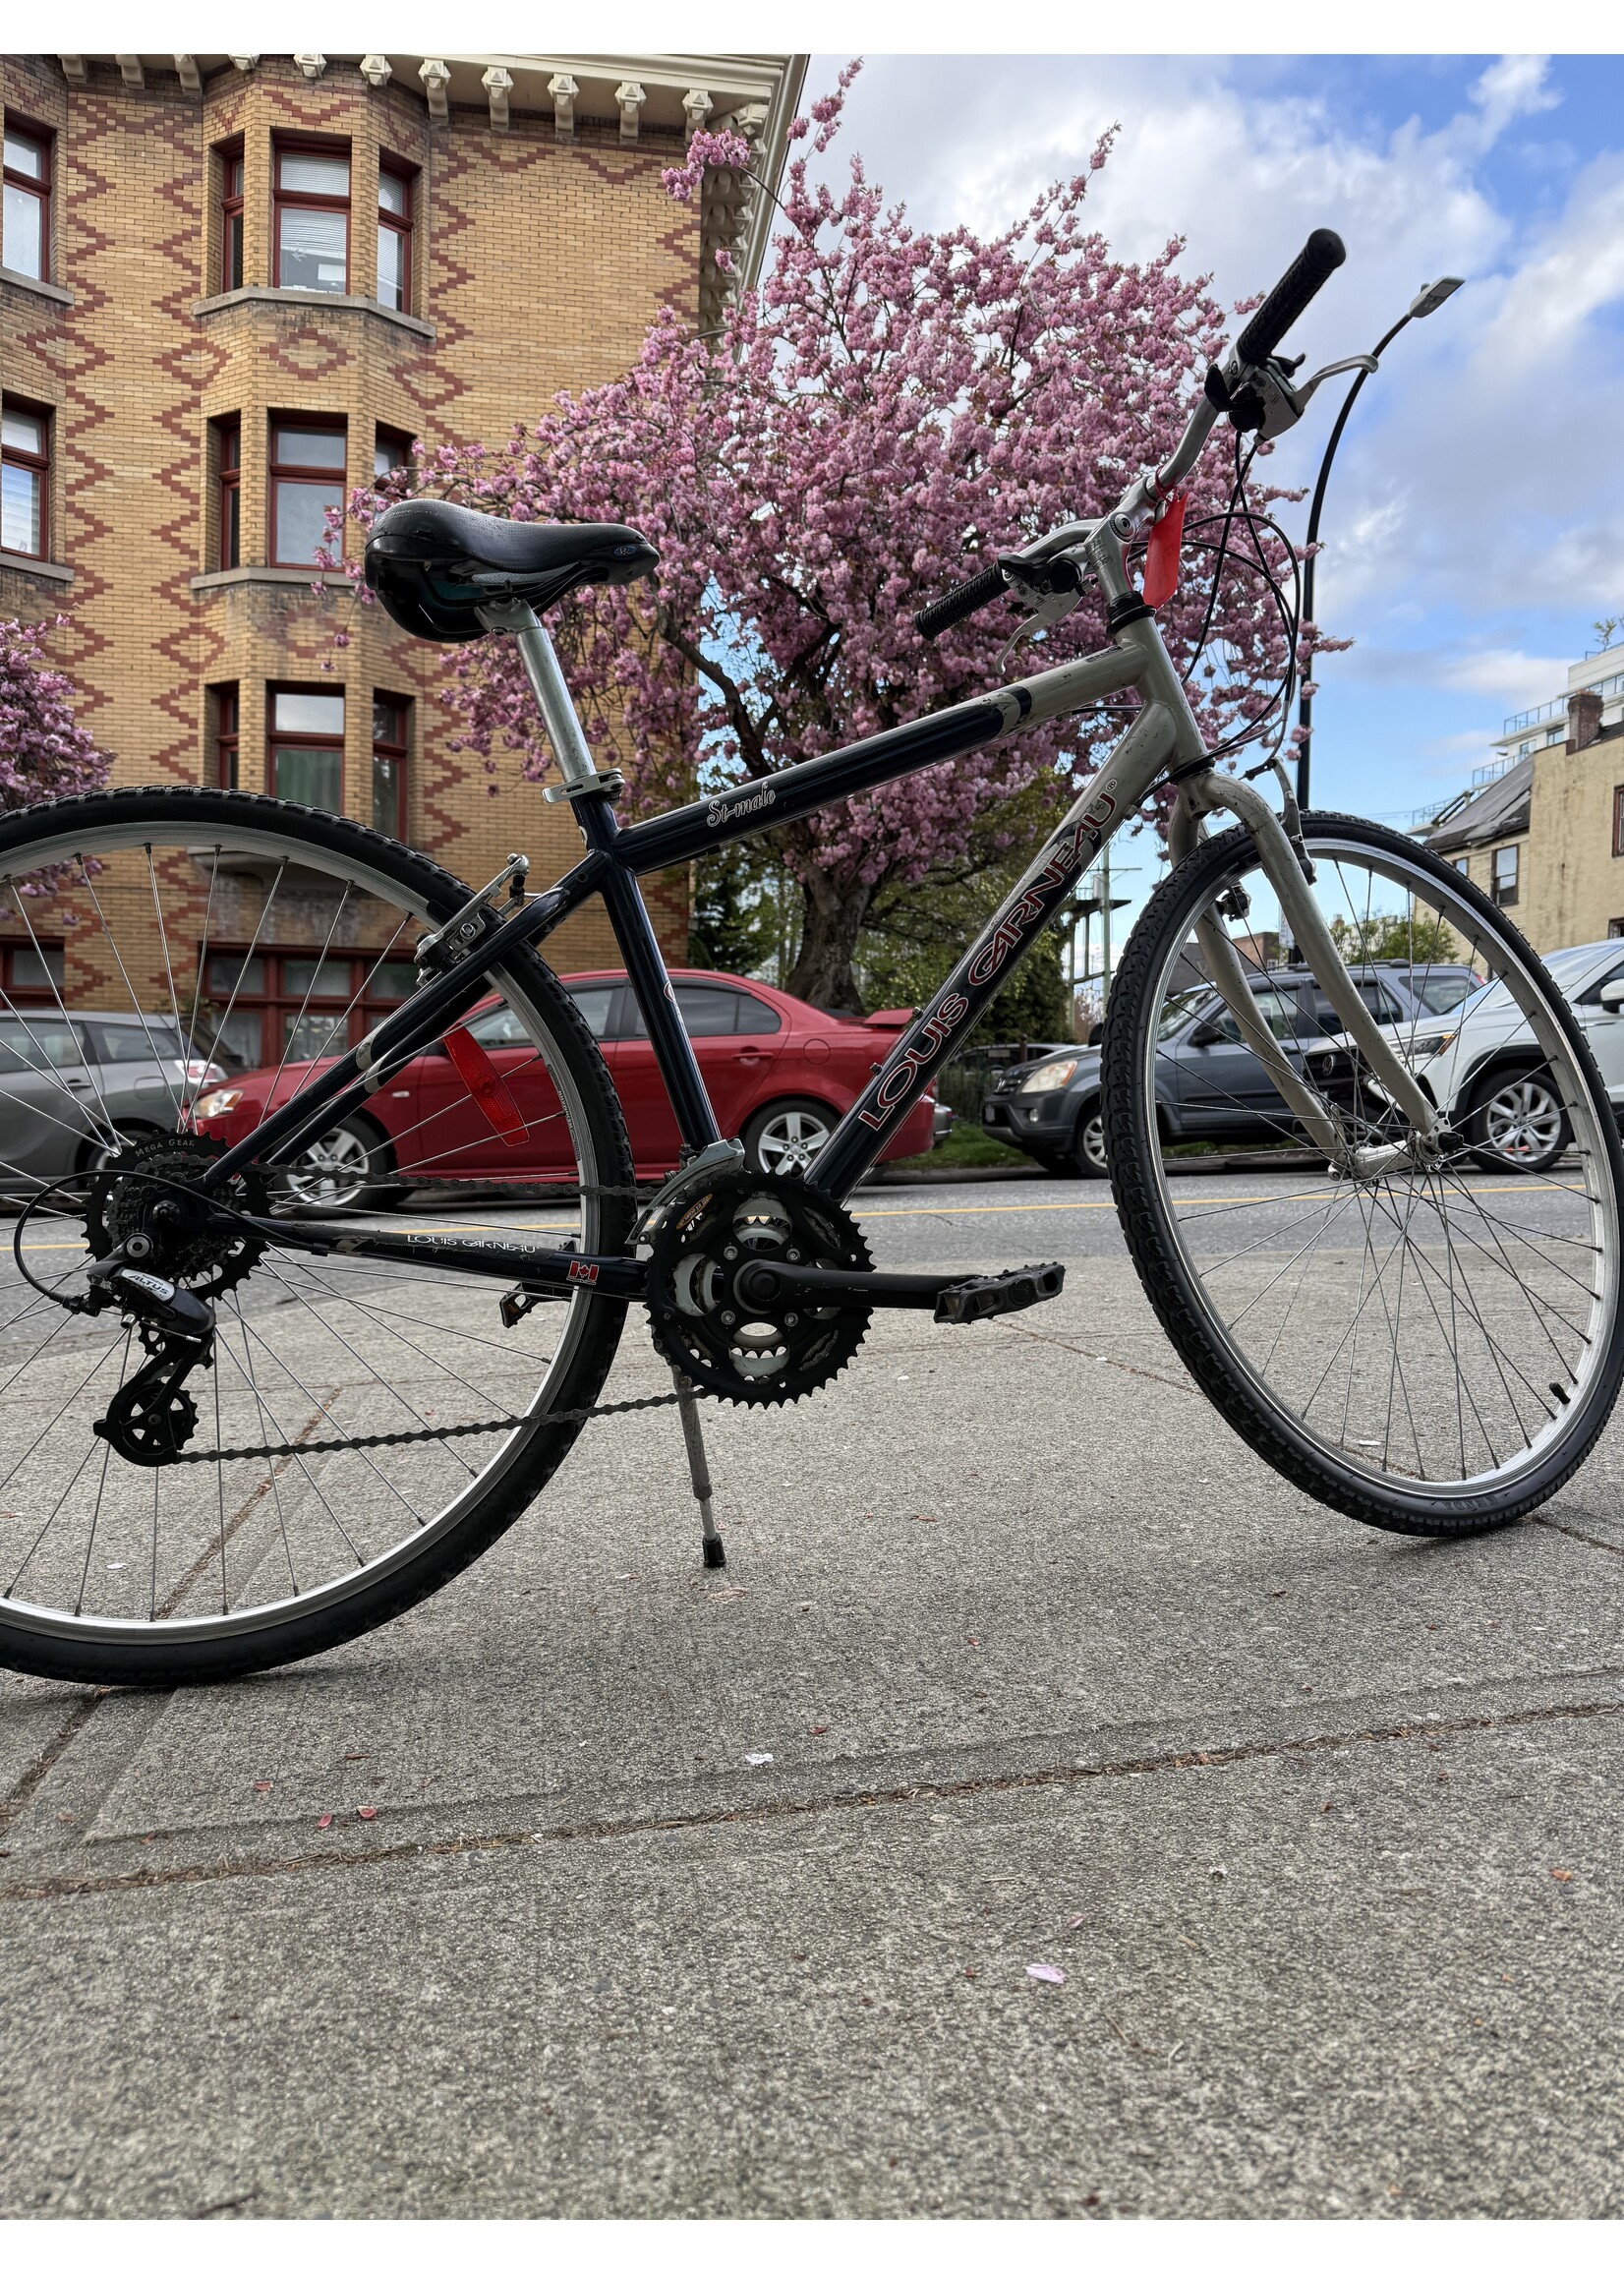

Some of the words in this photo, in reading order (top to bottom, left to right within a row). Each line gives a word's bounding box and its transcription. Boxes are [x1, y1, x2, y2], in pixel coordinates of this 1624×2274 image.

[706, 781, 777, 828] St-malo
[857, 992, 969, 1132] LOUIS
[967, 791, 1118, 986] GARNEAU
[135, 1141, 163, 1157] MEGA
[168, 1138, 195, 1147] GEAR
[407, 1234, 458, 1246] LOUIS
[128, 1274, 169, 1295] ALTUS
